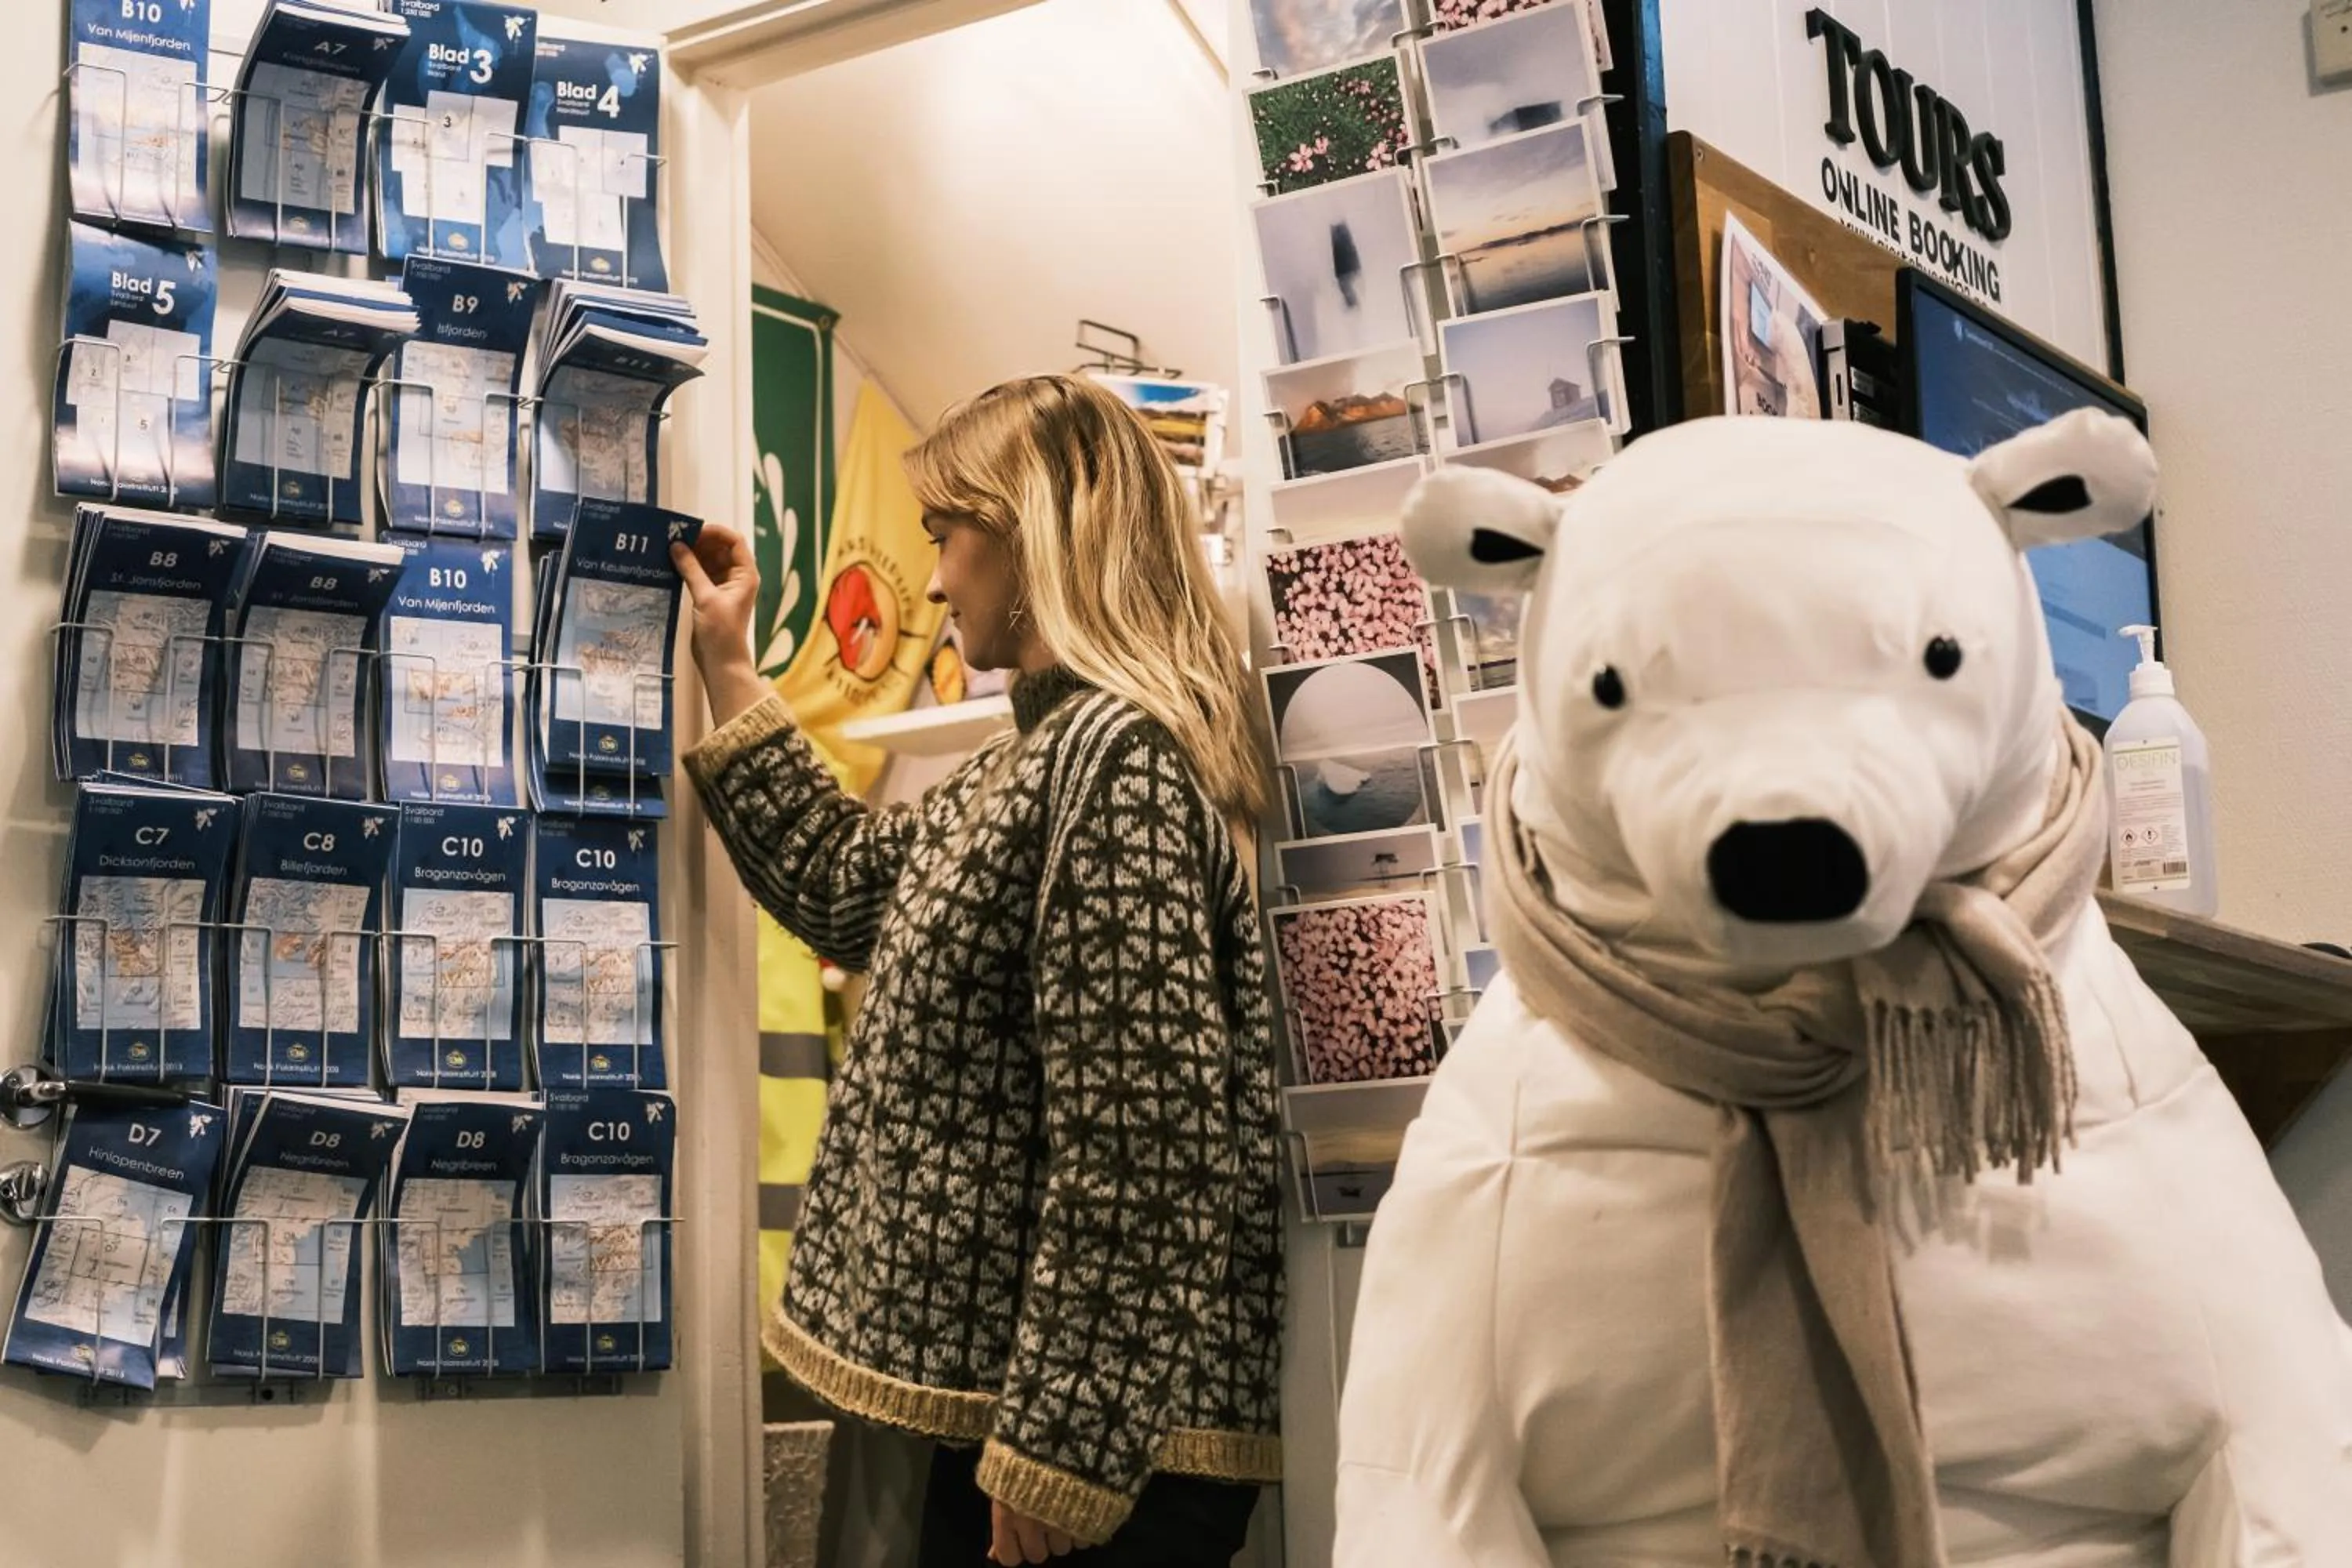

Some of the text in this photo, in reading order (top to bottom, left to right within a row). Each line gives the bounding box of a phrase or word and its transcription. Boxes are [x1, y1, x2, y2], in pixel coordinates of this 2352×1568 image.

[122, 0, 162, 23] B10
[87, 23, 191, 51] Van Mijenfjorden
[314, 41, 347, 55] A7
[429, 43, 492, 84] Blad 3
[557, 81, 620, 118] Blad 4
[1806, 7, 2012, 241] TOURS
[1821, 157, 1901, 245] ONLINE
[1908, 209, 2001, 304] BOOKING
[112, 270, 176, 315] Blad 5
[452, 294, 478, 314] B9
[437, 322, 488, 339] Isfjorden
[615, 533, 649, 554] B11
[150, 551, 178, 568] B8
[576, 557, 597, 571] Van
[310, 576, 338, 590] B8
[430, 568, 466, 589] B10
[398, 596, 495, 615] Van Mijenfjorden
[405, 806, 445, 817] Svalbard
[136, 826, 169, 846] C7
[303, 832, 336, 851] C8
[442, 837, 484, 858] C10
[99, 854, 195, 870] Dicksonfjorden
[281, 858, 347, 877] Billefjorden
[576, 848, 615, 869] C10
[415, 866, 506, 883] Braganzavågen
[551, 877, 640, 893] Braganzavågen
[128, 1123, 162, 1148] D7
[310, 1131, 341, 1149] D8
[456, 1131, 486, 1149] D8
[588, 1122, 630, 1142] C10
[89, 1146, 185, 1181] Hinlopenbreen
[561, 1152, 655, 1167] Braganzavågen
